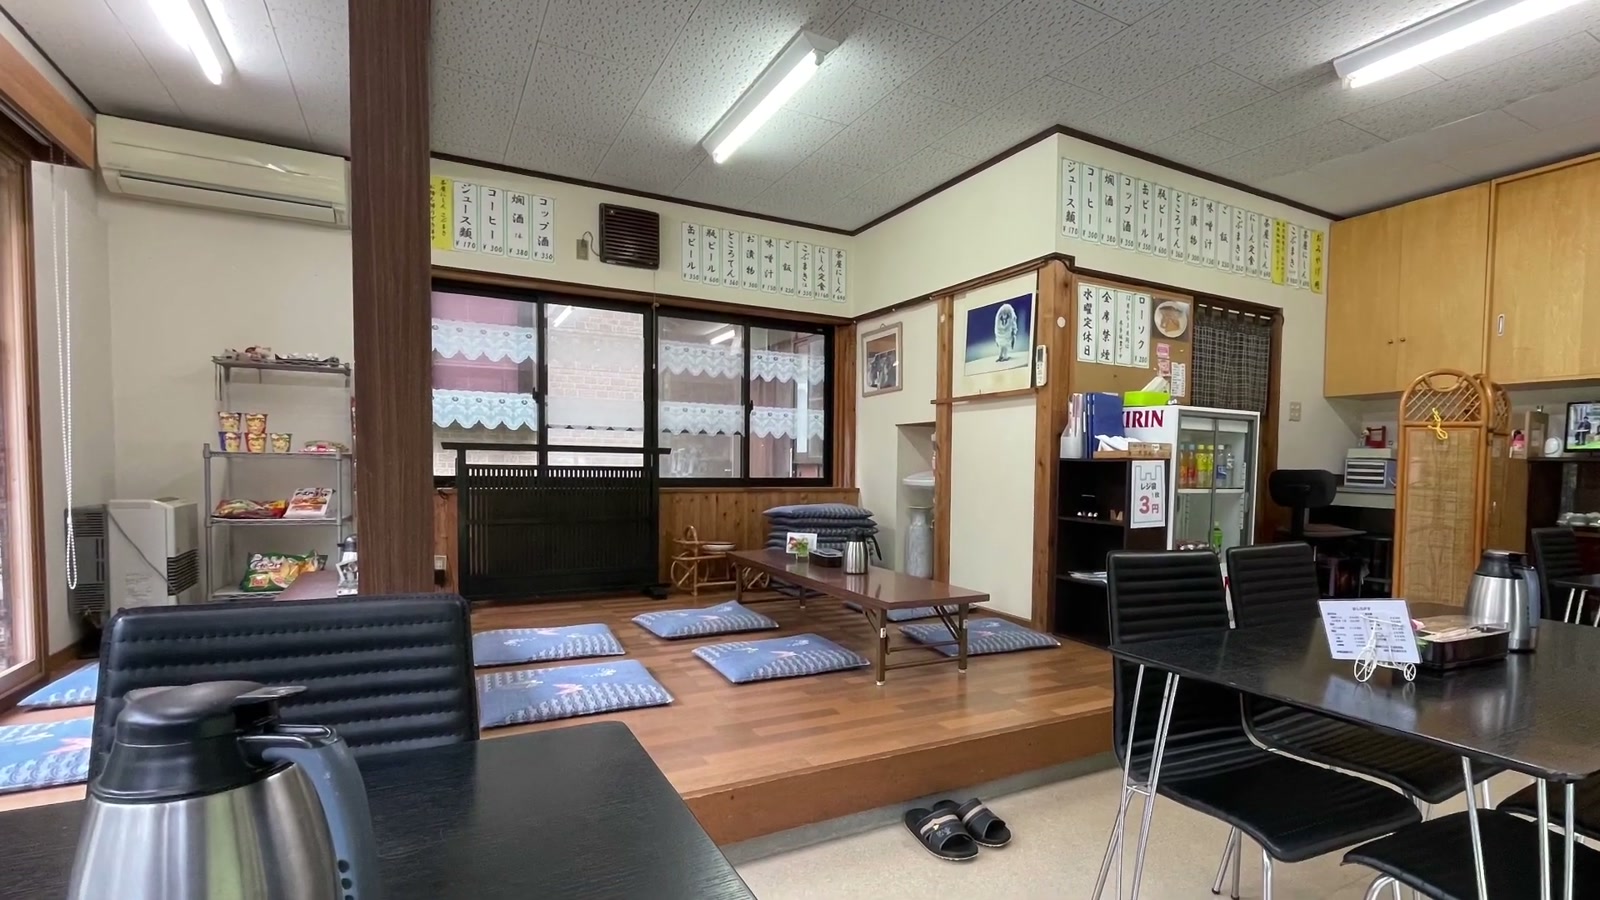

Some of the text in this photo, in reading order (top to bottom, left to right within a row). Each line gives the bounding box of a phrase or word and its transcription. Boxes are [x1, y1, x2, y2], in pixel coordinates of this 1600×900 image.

[458, 184, 472, 240] ジュース類
[488, 189, 497, 240] コーヒー
[1066, 161, 1075, 224] ジュース類
[1123, 178, 1131, 233] コップ酒
[455, 240, 476, 249] ¥170
[538, 198, 549, 247] コップ酒
[483, 244, 502, 253] ¥300
[687, 225, 695, 270] 缶ビール
[727, 231, 735, 278] ところてん
[1083, 288, 1093, 356] 水曜定休日
[1101, 292, 1111, 361] 全席禁煙
[1138, 496, 1160, 514] 3円
[1140, 482, 1157, 490] レジ袋
